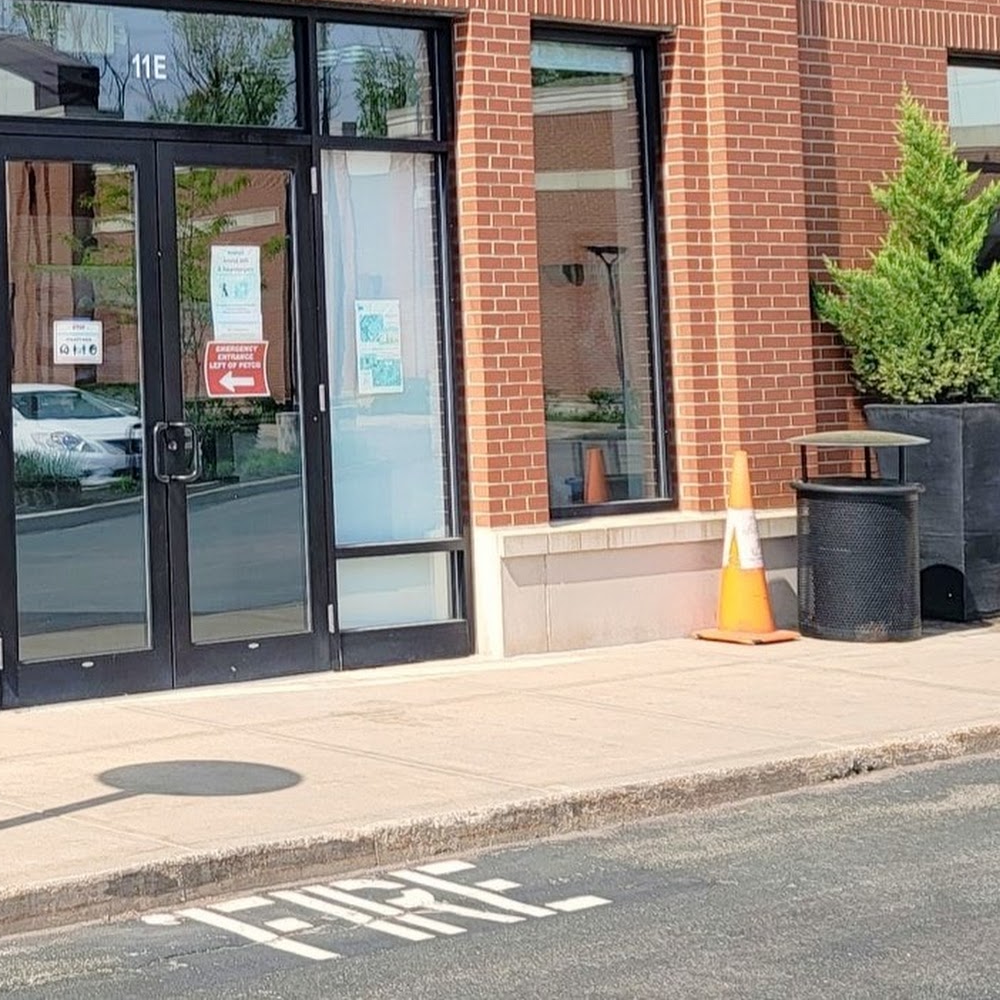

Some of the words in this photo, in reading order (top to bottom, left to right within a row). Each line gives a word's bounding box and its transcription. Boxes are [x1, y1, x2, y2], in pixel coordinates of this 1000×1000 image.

[131, 52, 168, 80] 11E
[215, 344, 259, 353] EMERGENCY
[216, 353, 255, 361] ENTRANCE
[209, 361, 227, 370] LEFT
[227, 361, 237, 370] OF
[174, 859, 613, 961] FIRE
